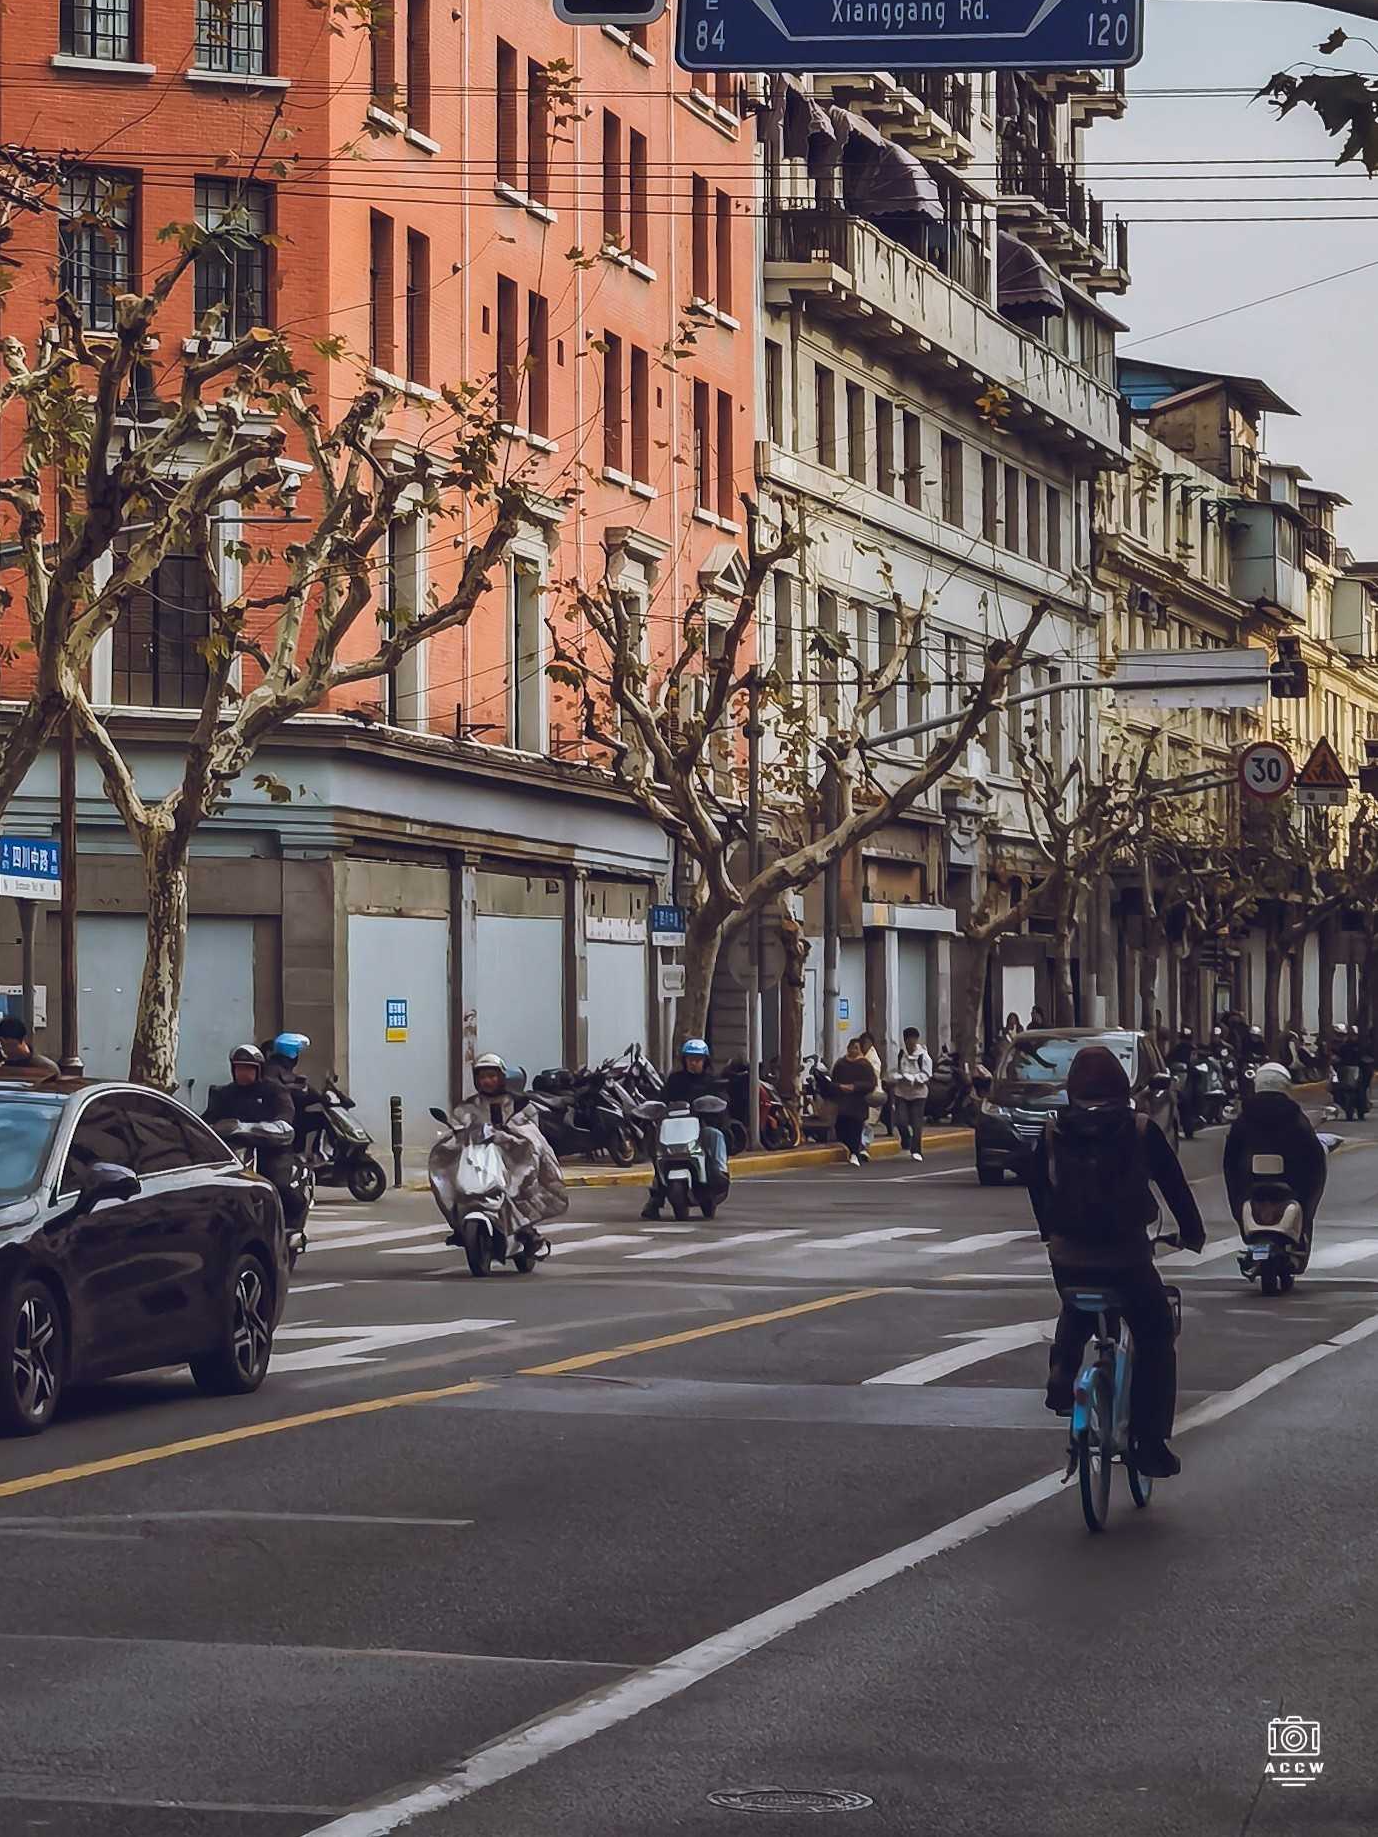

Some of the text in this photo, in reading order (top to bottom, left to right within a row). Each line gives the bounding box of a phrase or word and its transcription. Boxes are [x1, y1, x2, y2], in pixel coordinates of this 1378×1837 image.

[695, 19, 726, 52] 84
[1088, 12, 1128, 47] 120
[1251, 757, 1282, 783] 30
[12, 845, 48, 872] 四川中路
